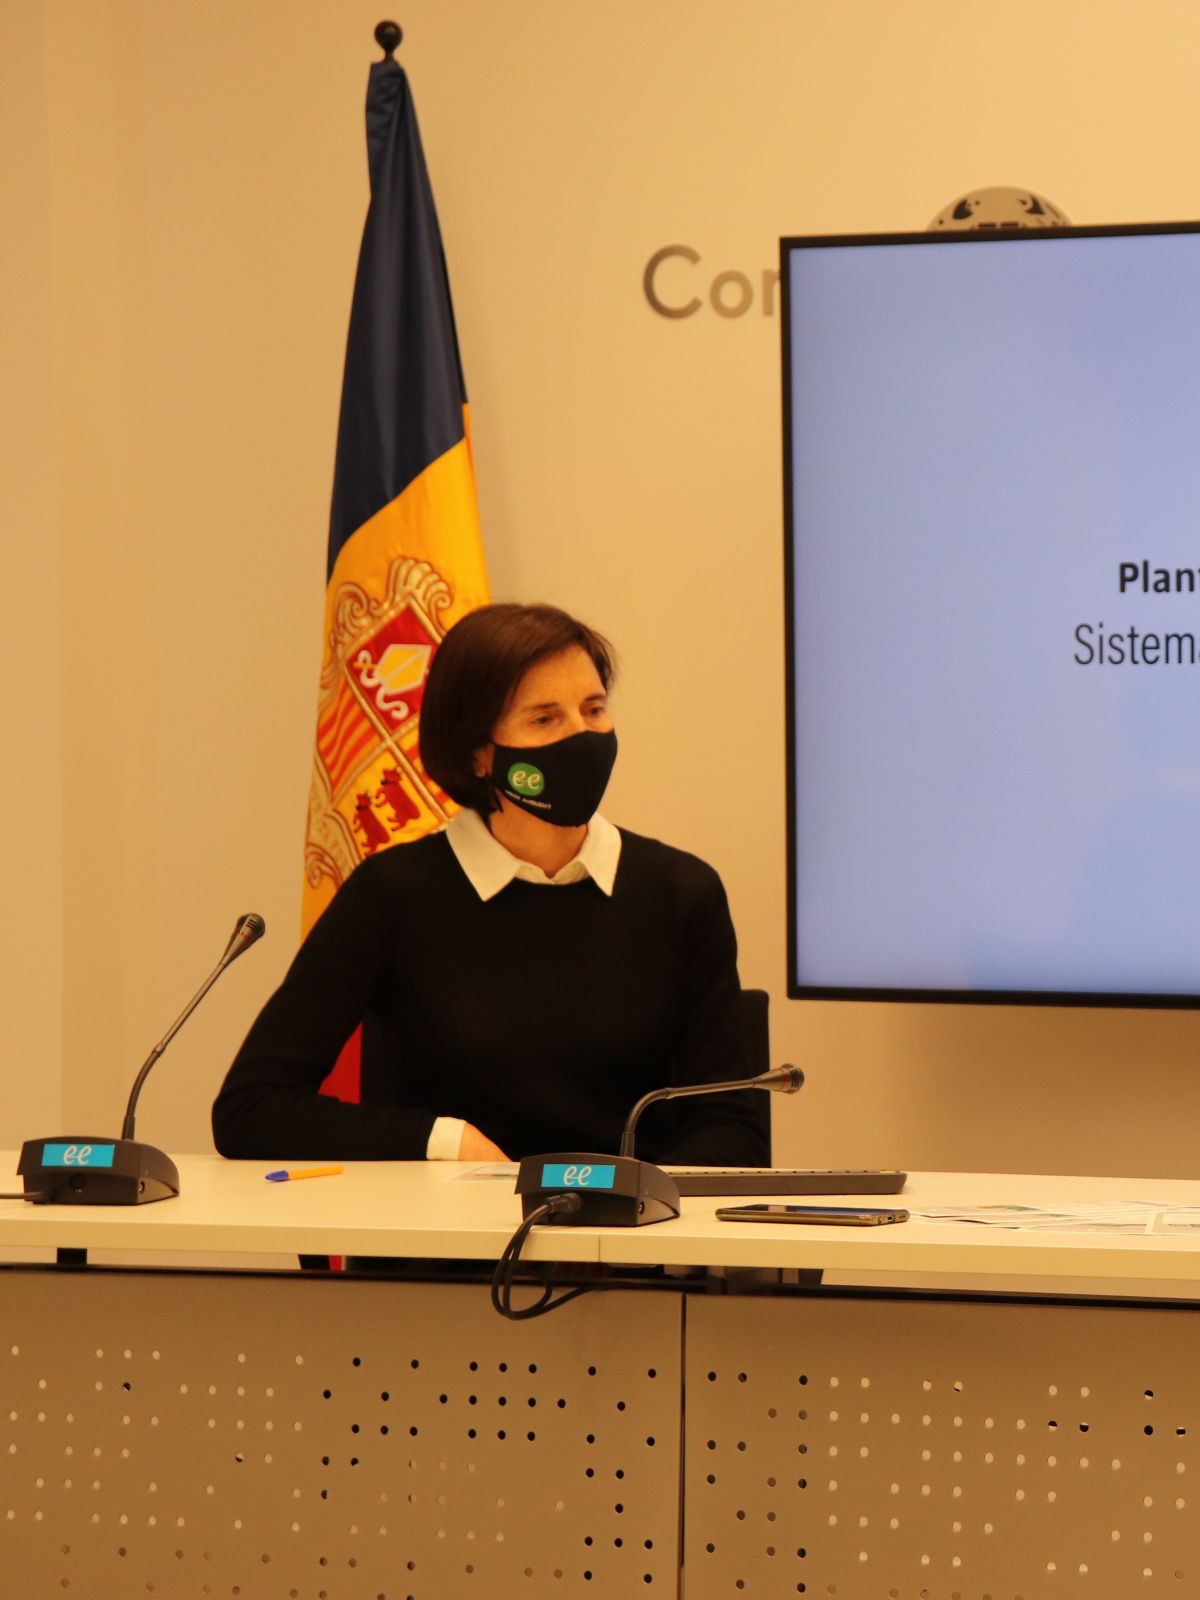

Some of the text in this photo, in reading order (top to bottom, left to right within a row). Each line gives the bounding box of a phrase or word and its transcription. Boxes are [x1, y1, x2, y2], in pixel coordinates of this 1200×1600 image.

[511, 770, 541, 790] ee
[63, 1144, 93, 1166] ee
[562, 1164, 593, 1187] ee
